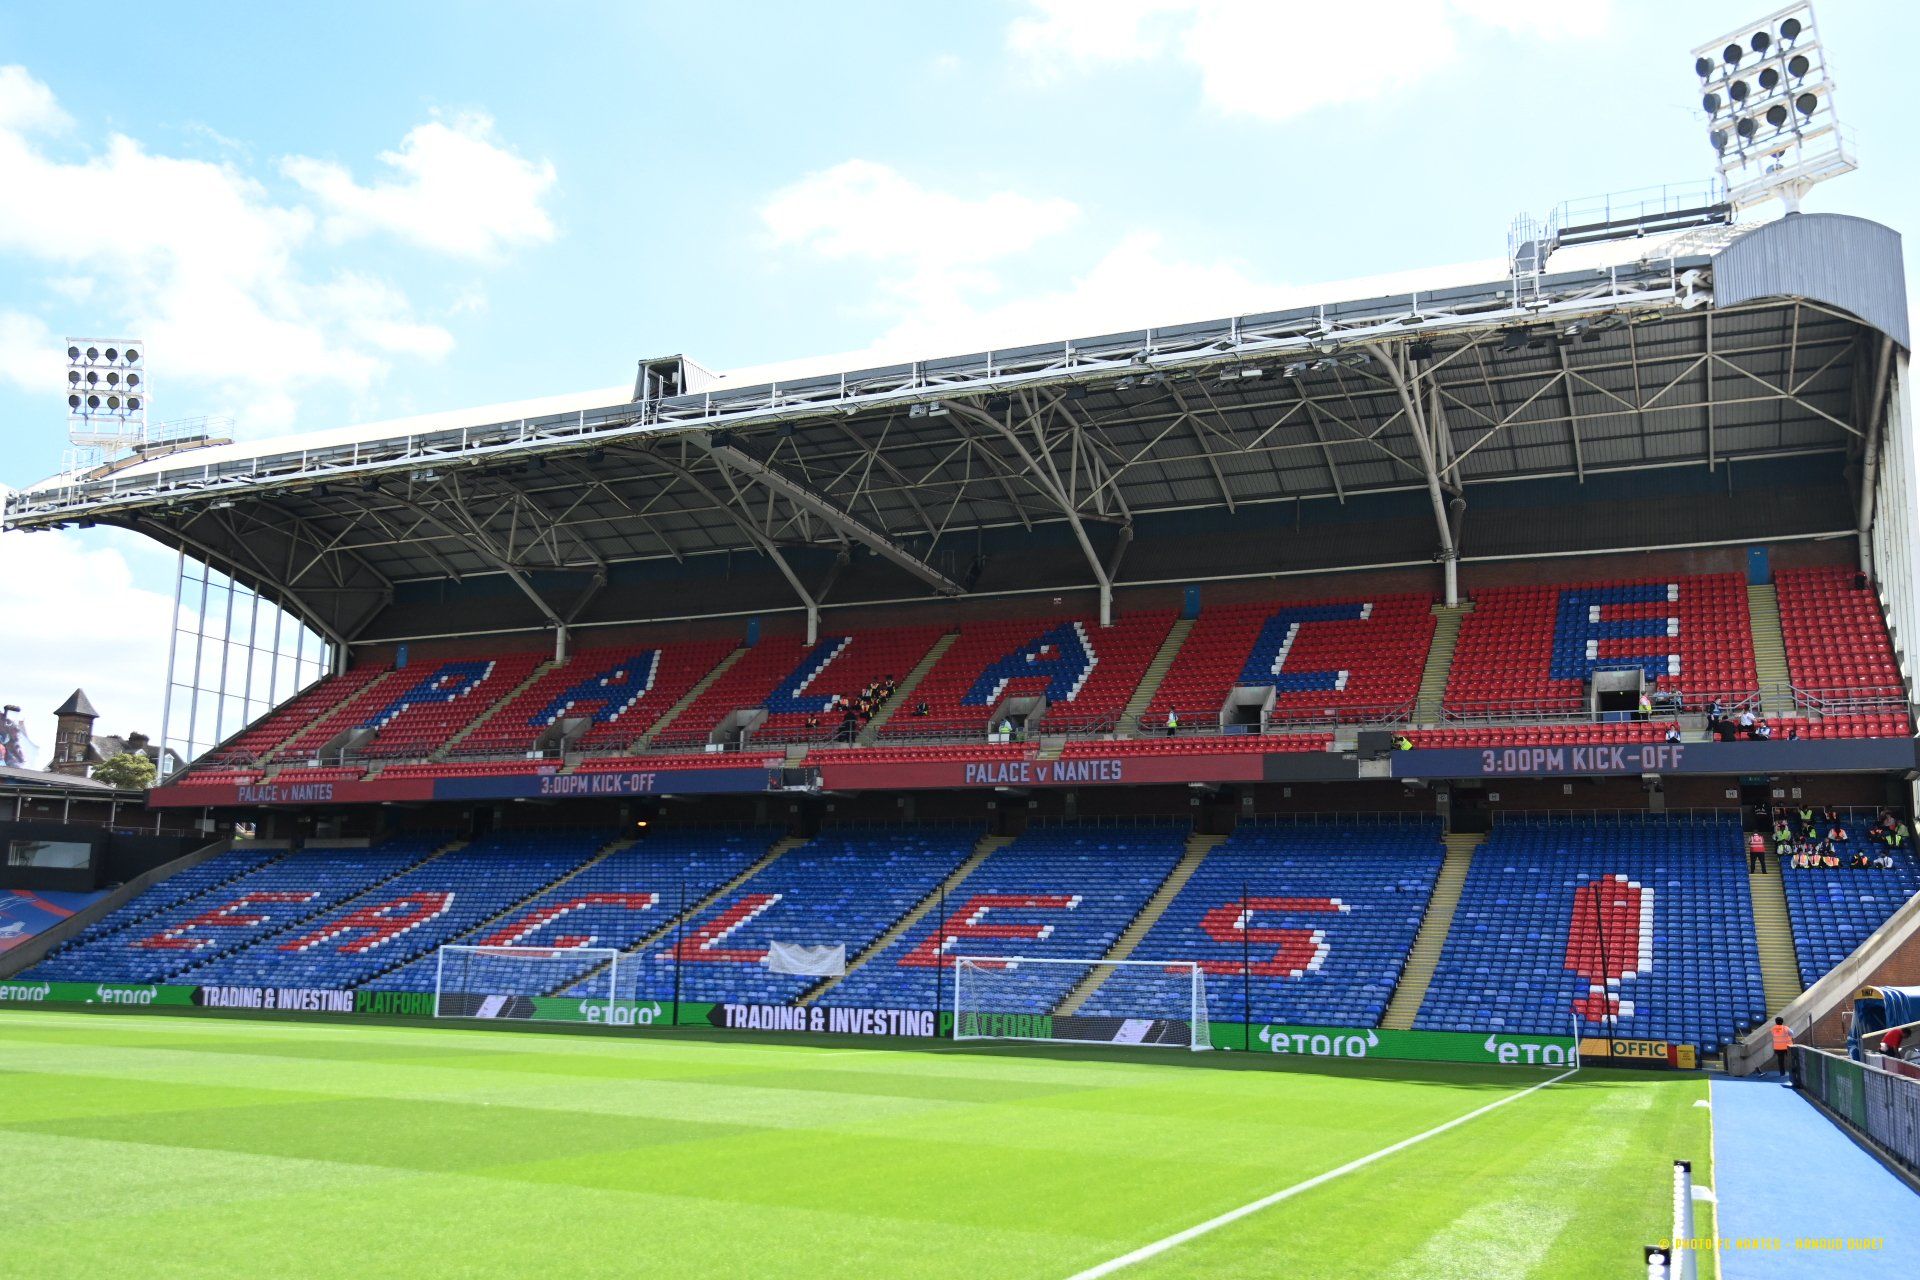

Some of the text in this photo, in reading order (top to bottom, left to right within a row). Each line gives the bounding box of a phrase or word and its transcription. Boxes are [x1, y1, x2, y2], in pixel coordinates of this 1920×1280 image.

[1482, 745, 1685, 772] 3:00PM KICK-OFF
[965, 763, 1030, 783] PALACE
[1053, 760, 1122, 781] NANTES
[239, 785, 278, 801] PALACE
[291, 784, 333, 800] NANTES
[541, 773, 656, 794] 3:00PM KICK-OFF
[202, 985, 435, 1015] TRADING & INVESTING PLATFORM
[723, 1003, 806, 1031] TRADING
[810, 1007, 825, 1032] &
[829, 1006, 935, 1037] INVESTING
[1613, 1041, 1666, 1057] OFFIC
